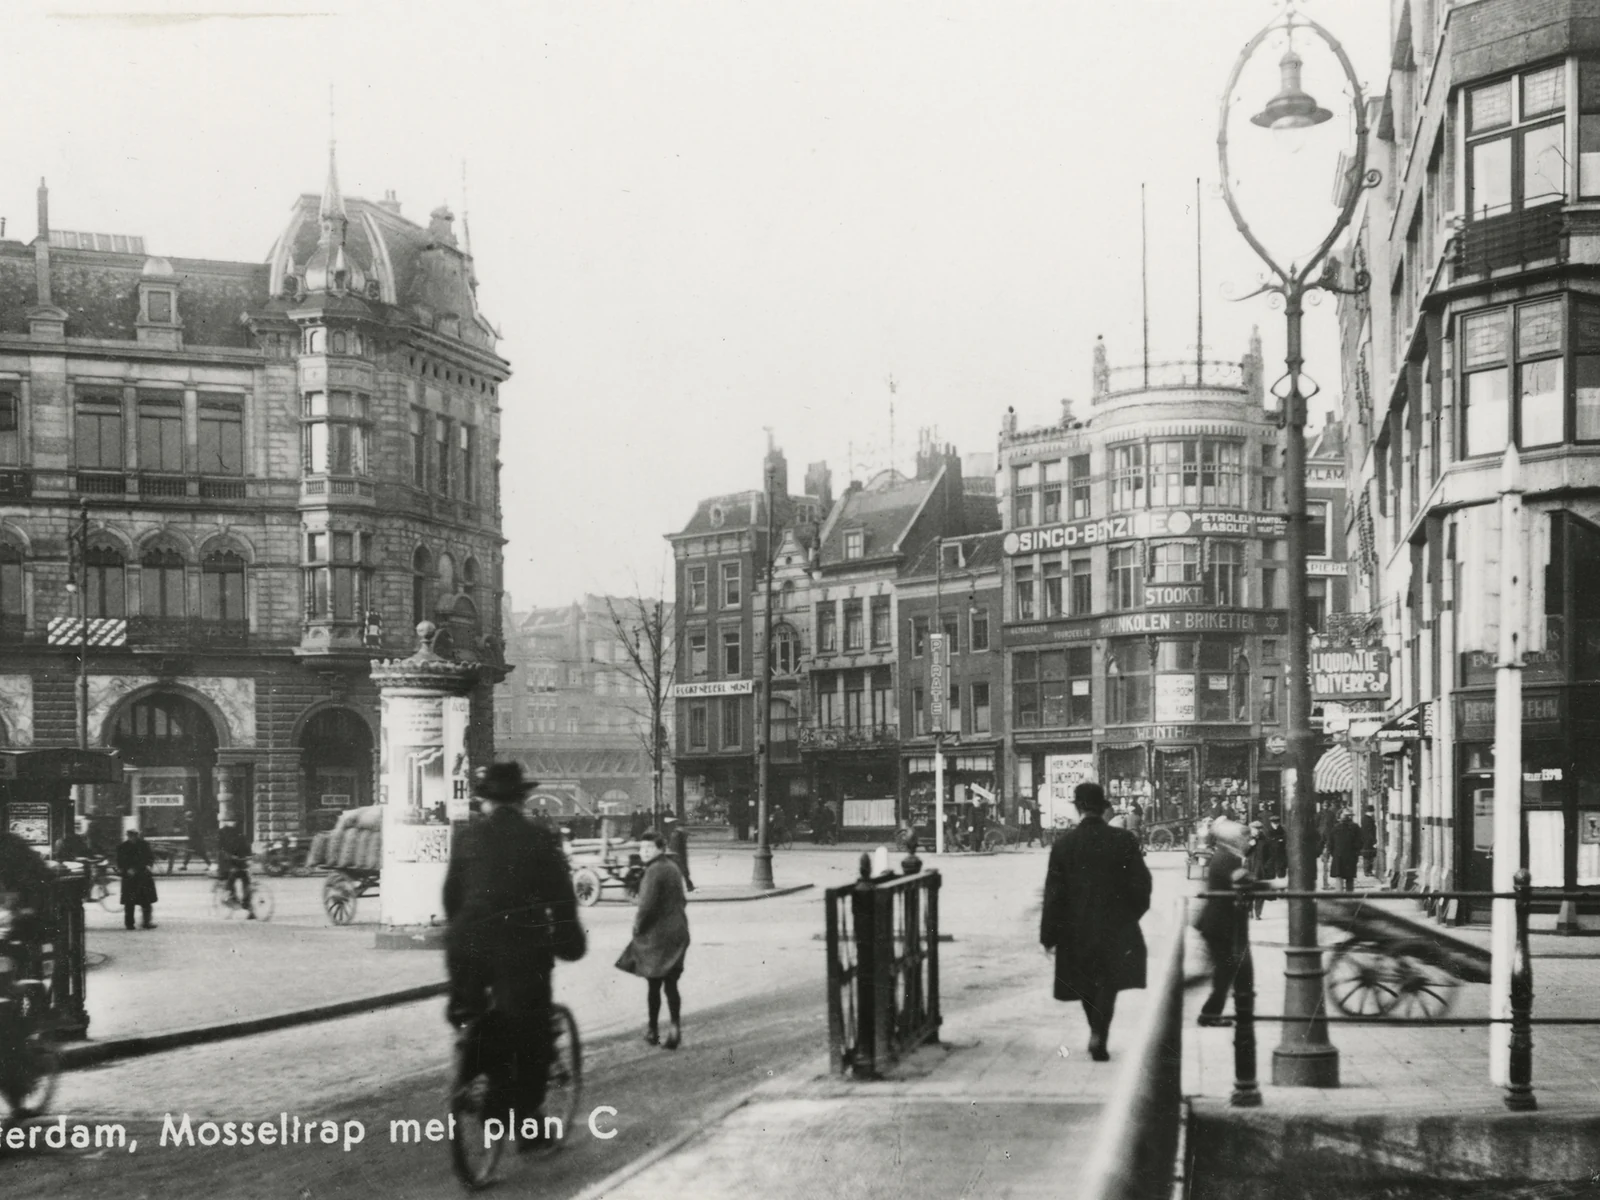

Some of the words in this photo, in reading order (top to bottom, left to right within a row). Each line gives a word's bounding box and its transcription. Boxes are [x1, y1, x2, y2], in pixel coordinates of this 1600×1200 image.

[1202, 522, 1249, 533] GASOLIE
[1145, 587, 1202, 605] STOOKT
[1313, 649, 1379, 673] LIQUIDATIE
[930, 640, 942, 715] PIRATE
